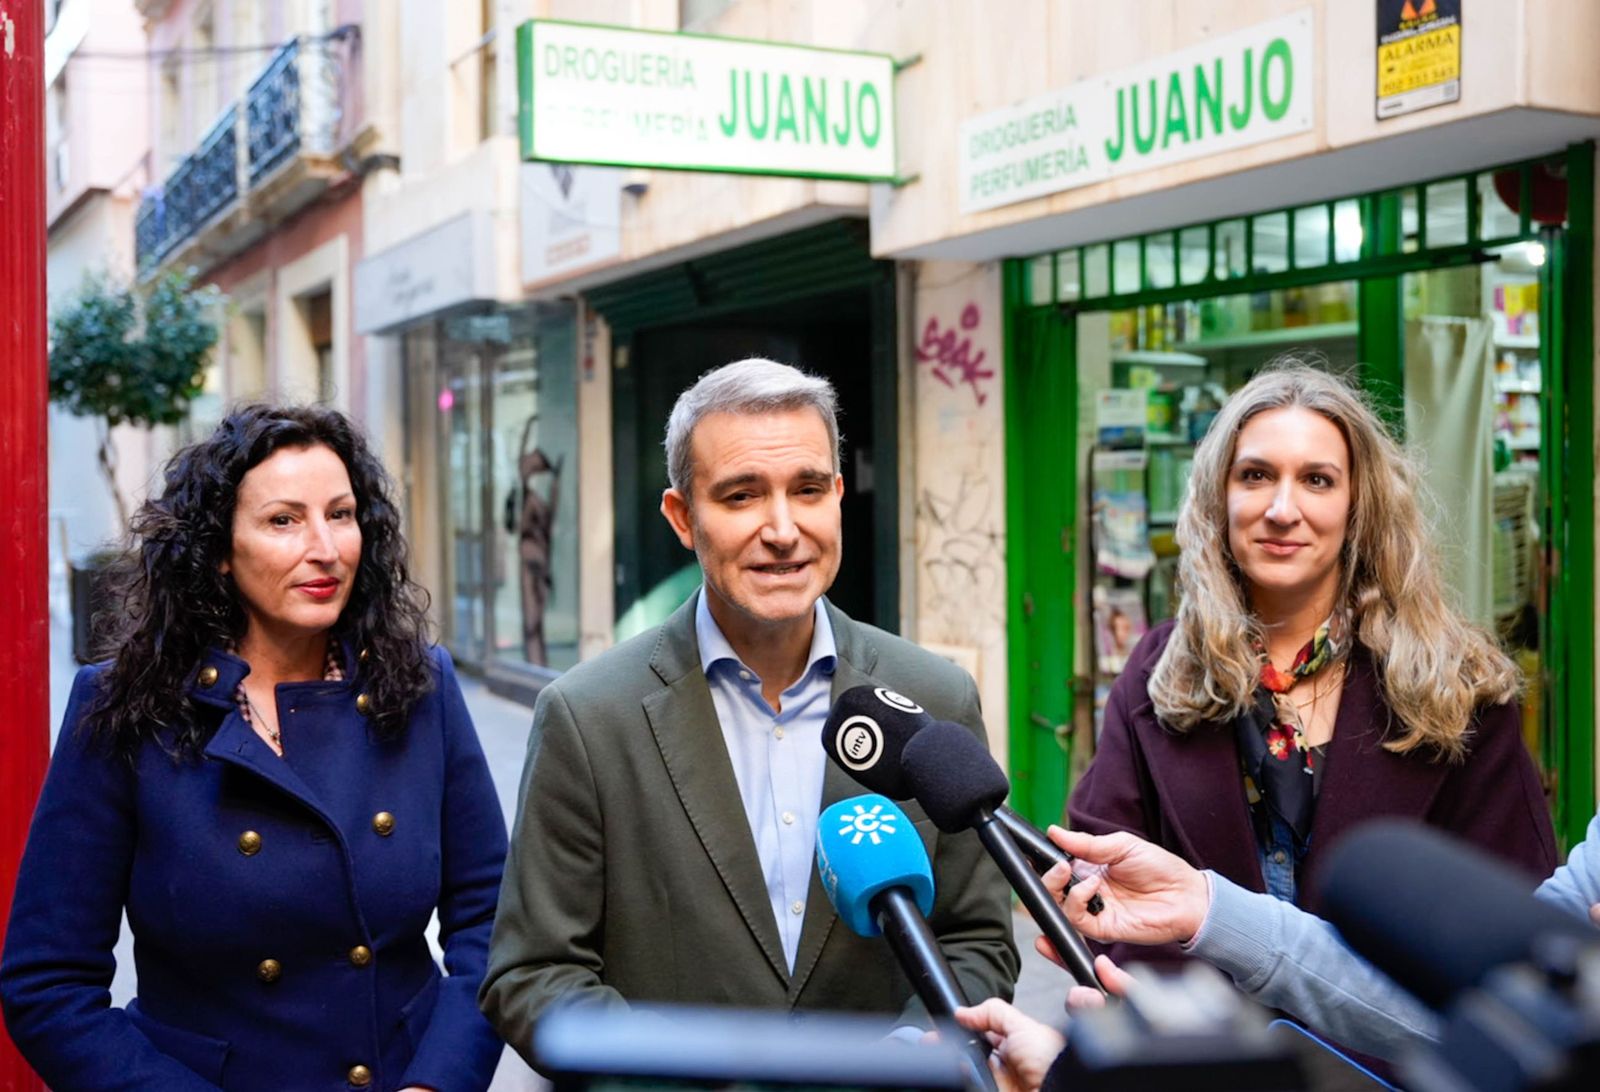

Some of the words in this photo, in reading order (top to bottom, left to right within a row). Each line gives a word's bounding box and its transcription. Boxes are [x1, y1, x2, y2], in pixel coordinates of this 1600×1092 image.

[544, 43, 696, 89] DROGUERÍA
[1384, 31, 1454, 61] ALARMA
[718, 68, 882, 149] JUANJO
[1104, 37, 1294, 162] JUANJO
[970, 137, 1090, 201] PERFUMERÍA
